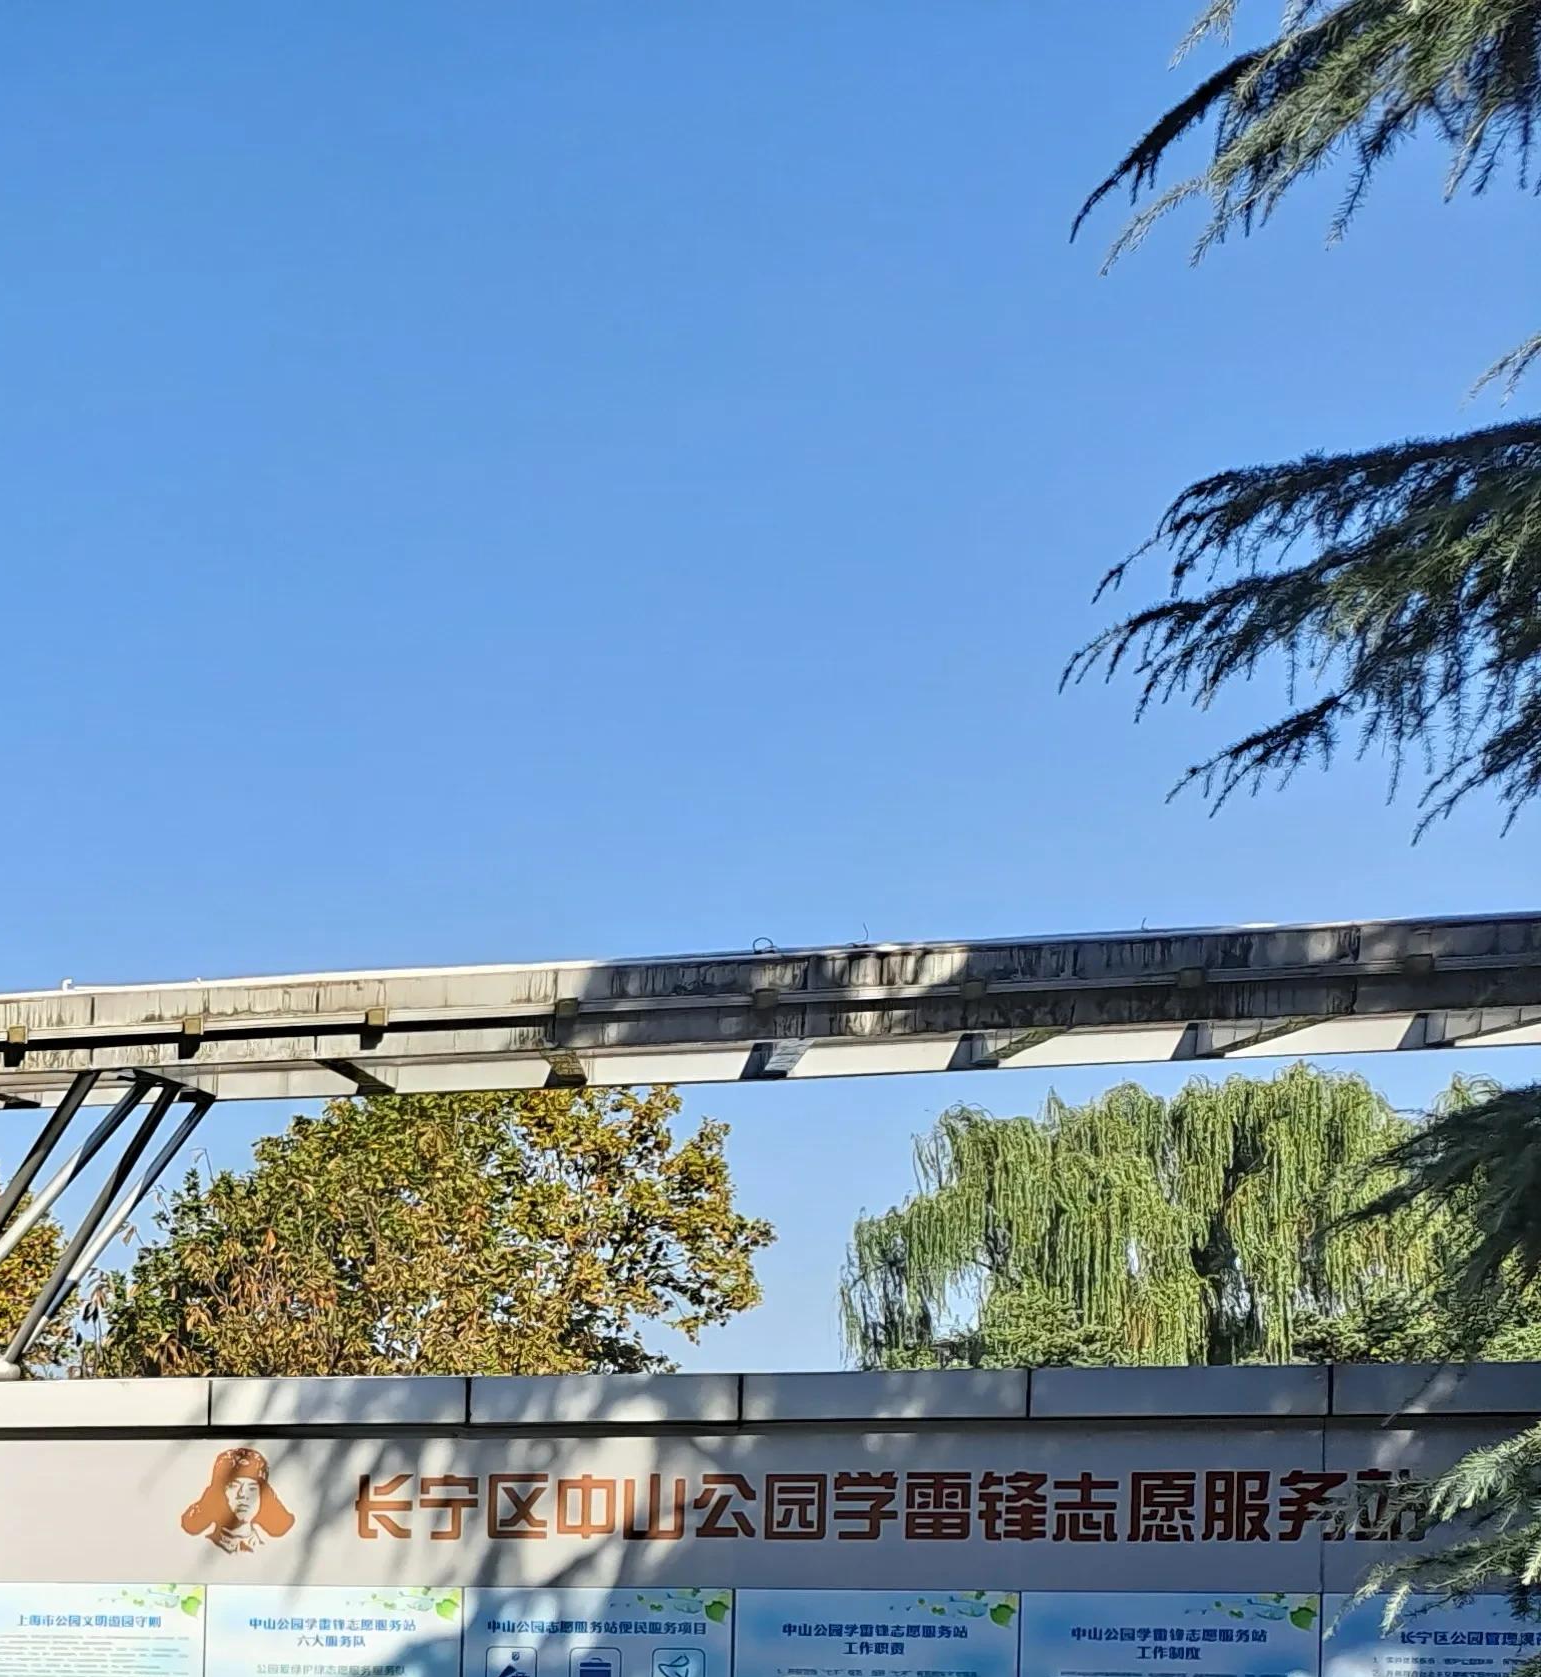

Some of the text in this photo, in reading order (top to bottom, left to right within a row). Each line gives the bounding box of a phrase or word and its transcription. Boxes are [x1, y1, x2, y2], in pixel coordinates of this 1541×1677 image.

[249, 1617, 416, 1632] 中山公园学雷锋志愿服务站
[487, 1620, 707, 1635] 中山公园志愿服务站便民服务项目
[782, 1623, 968, 1639] 中山公园学雷锋志愿服务站
[297, 1635, 366, 1648] 六大服务队
[1071, 1627, 1267, 1643] 中山公园学雷锋志愿服务站
[843, 1642, 905, 1656] 工作职责
[1136, 1646, 1201, 1660] 工作制度
